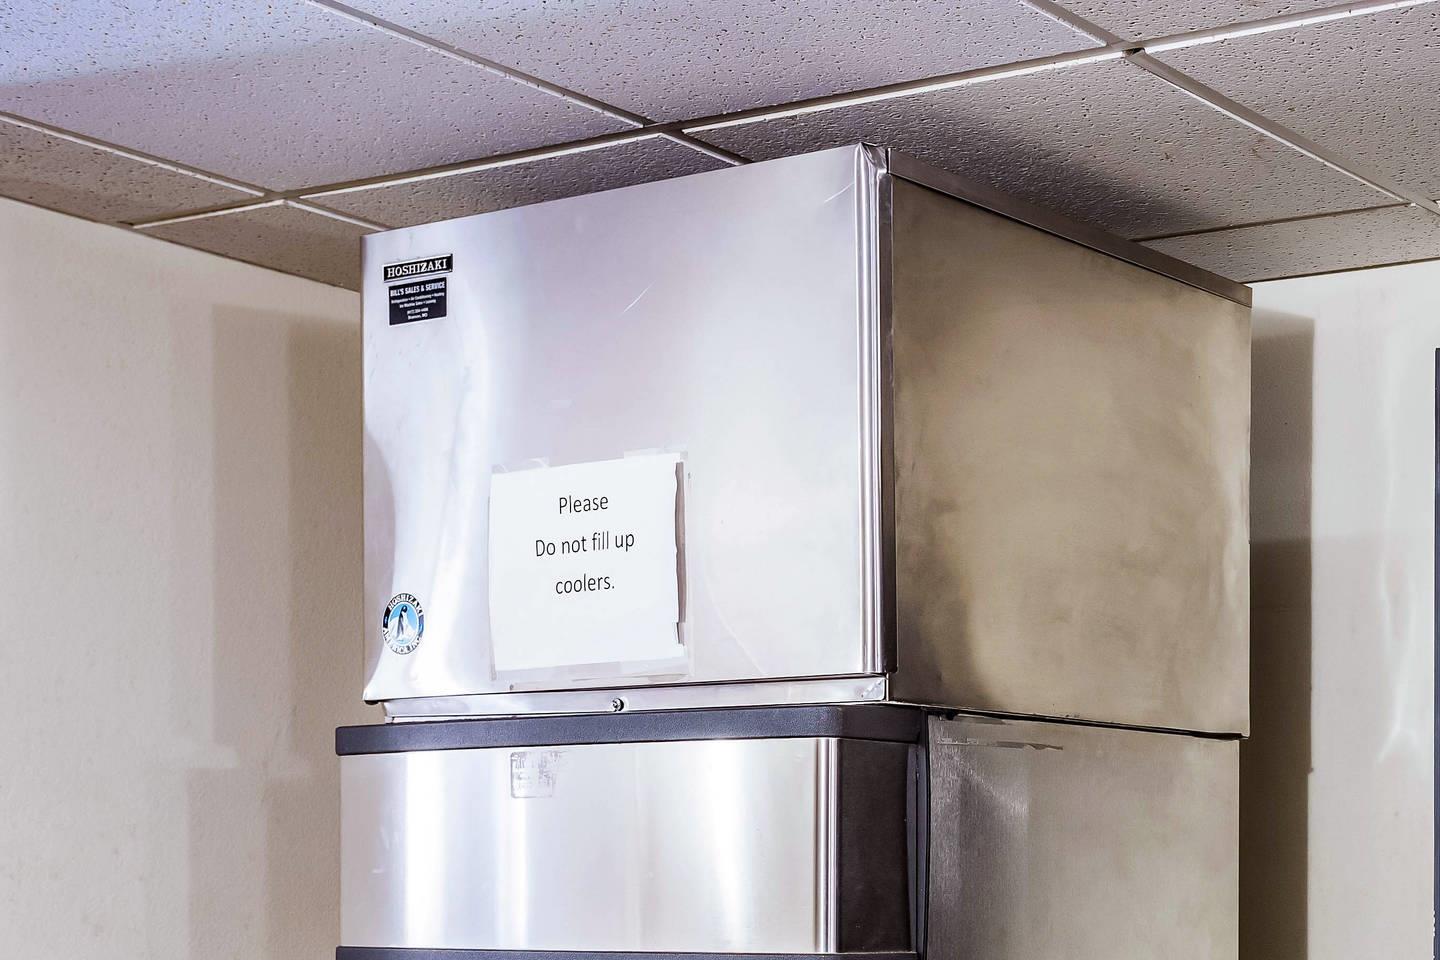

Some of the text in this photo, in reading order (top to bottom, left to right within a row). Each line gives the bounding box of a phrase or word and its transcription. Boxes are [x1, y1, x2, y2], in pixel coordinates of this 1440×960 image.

[387, 259, 447, 277] HOSHIZAKI
[405, 286, 420, 295] SALES
[425, 281, 445, 291] SERVICE
[559, 495, 609, 514] Please
[535, 530, 635, 557] Do not fill up
[556, 573, 615, 595] coolers.
